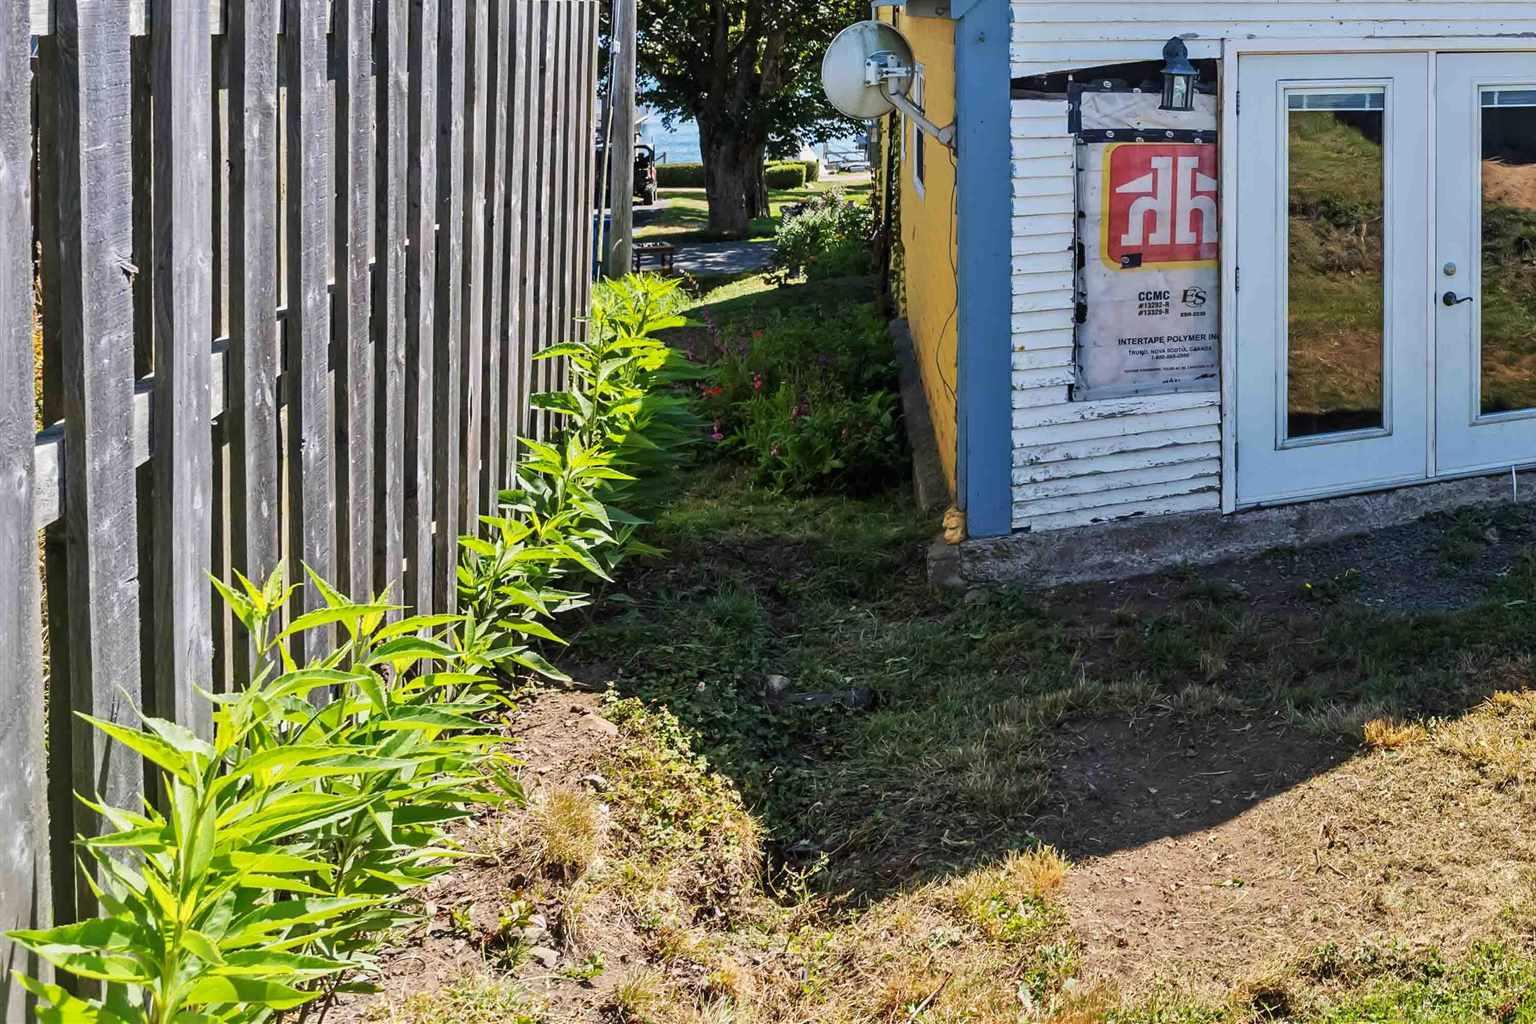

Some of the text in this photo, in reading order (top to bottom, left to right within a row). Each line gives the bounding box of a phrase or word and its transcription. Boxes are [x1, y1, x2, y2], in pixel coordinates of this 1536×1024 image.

[1138, 290, 1170, 302] CCMC
[1118, 335, 1165, 346] INTERTAPE
[1166, 333, 1207, 344] POLYMER
